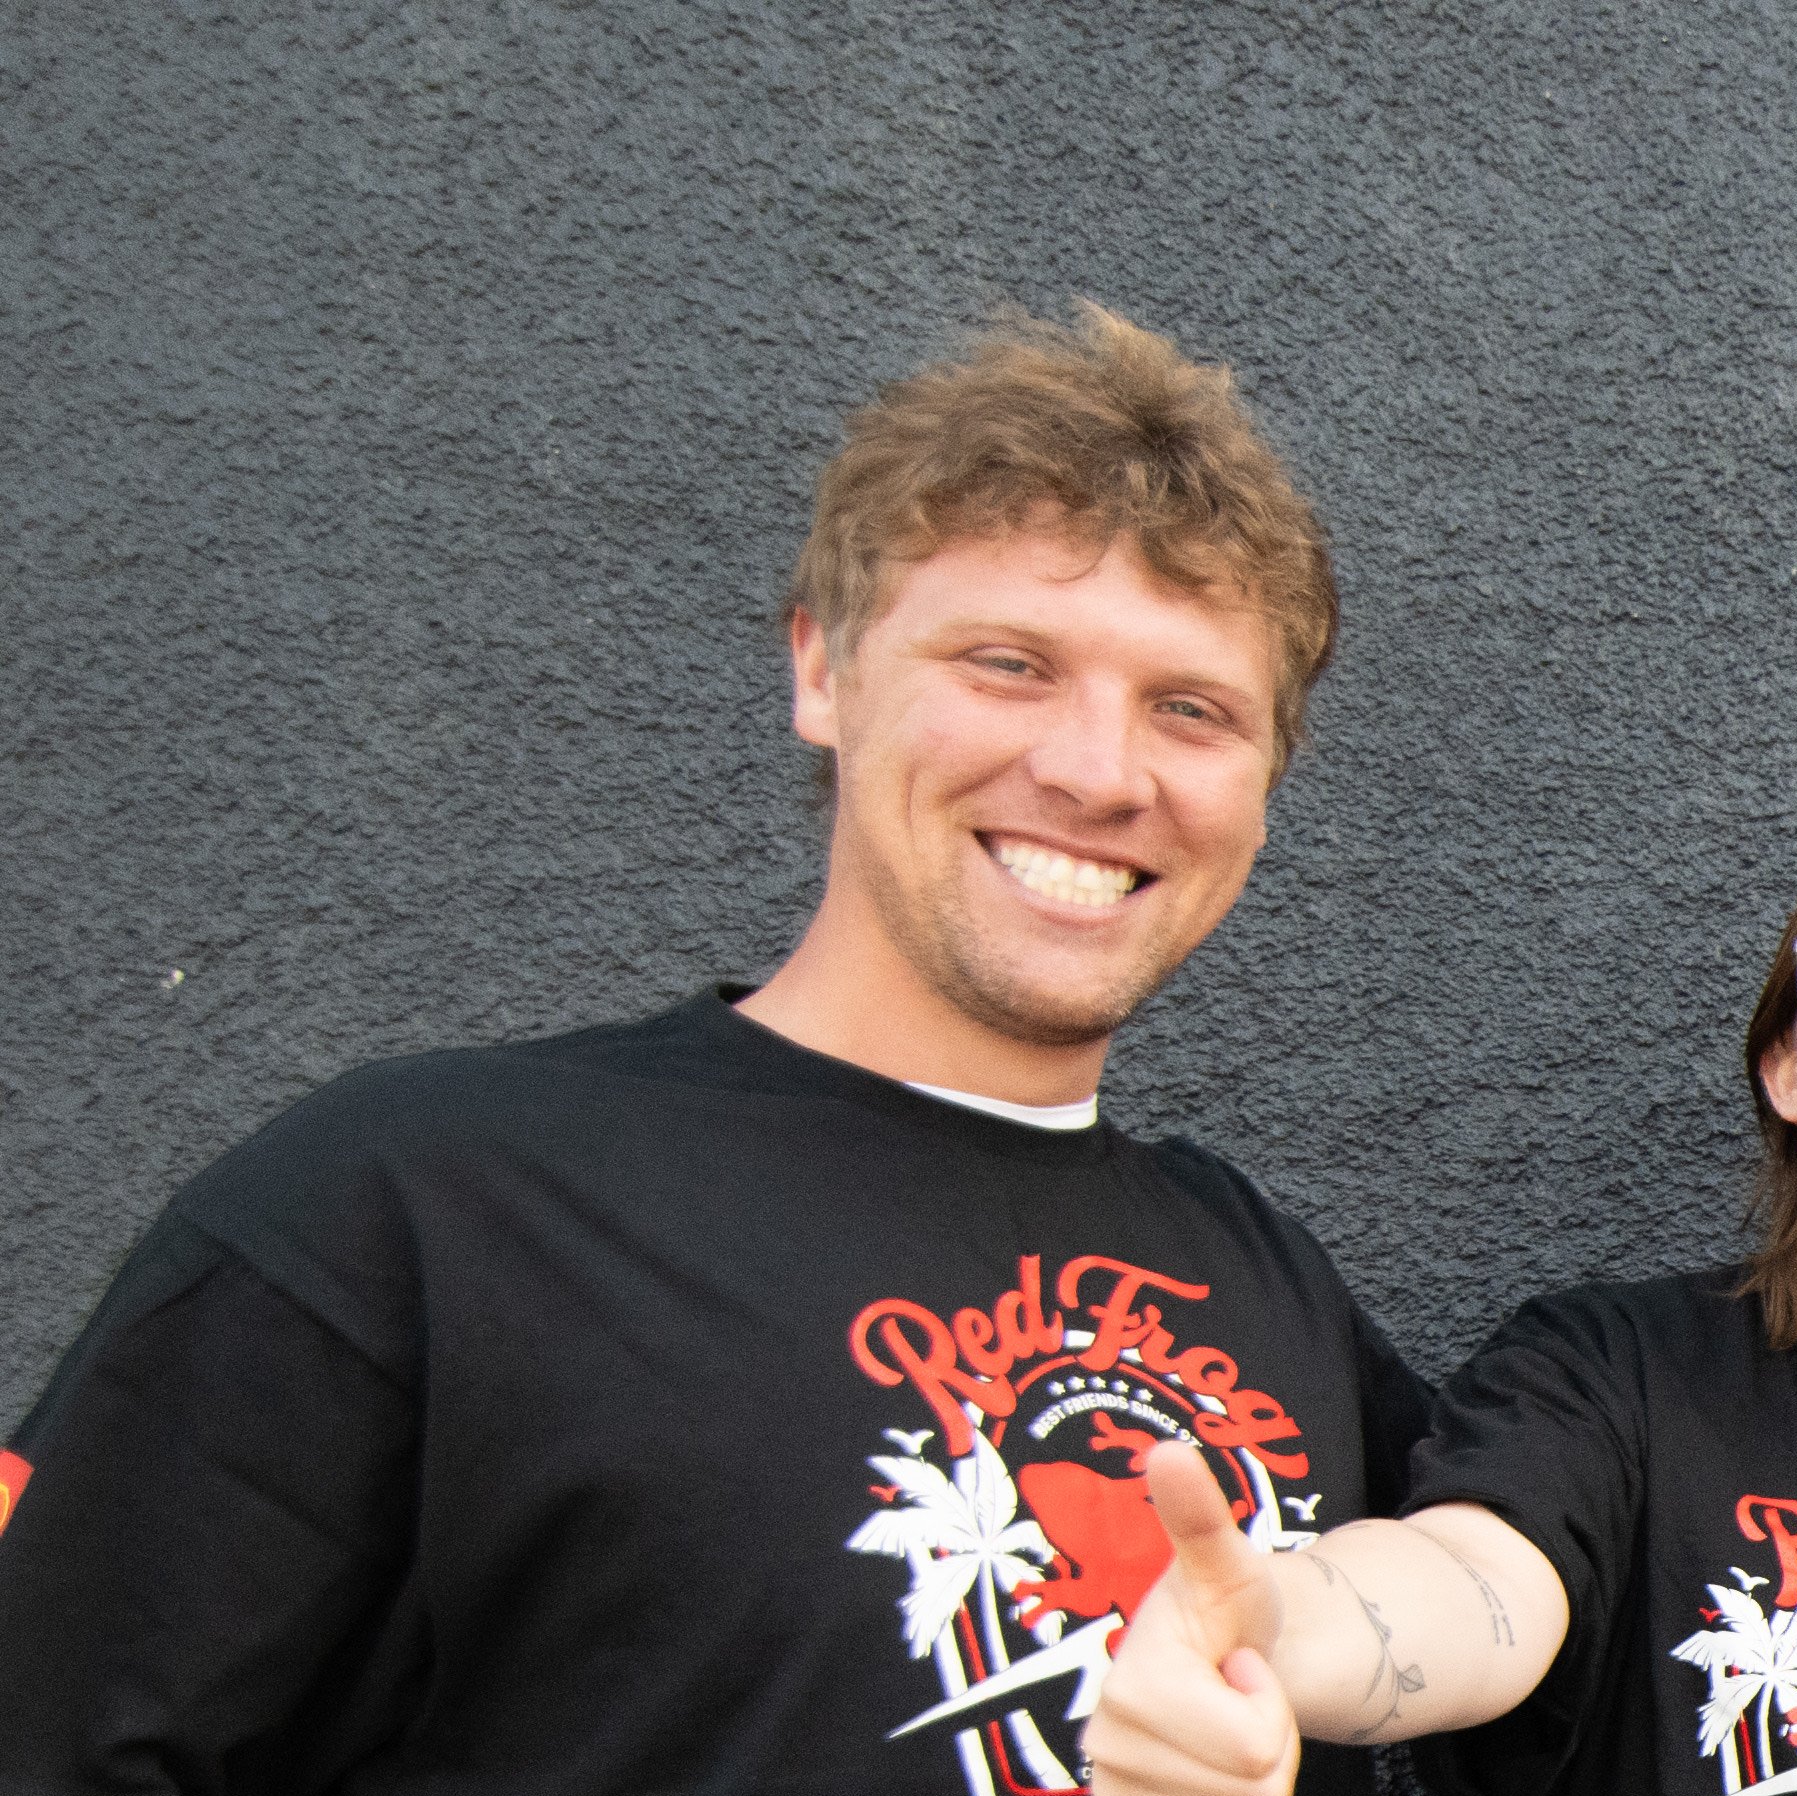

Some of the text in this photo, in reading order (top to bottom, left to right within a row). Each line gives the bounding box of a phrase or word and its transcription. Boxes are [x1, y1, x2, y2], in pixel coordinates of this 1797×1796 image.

[848, 1253, 1309, 1478] Red Frog
[1061, 1392, 1130, 1416] FRIENDS
[1129, 1400, 1180, 1434] SINCE
